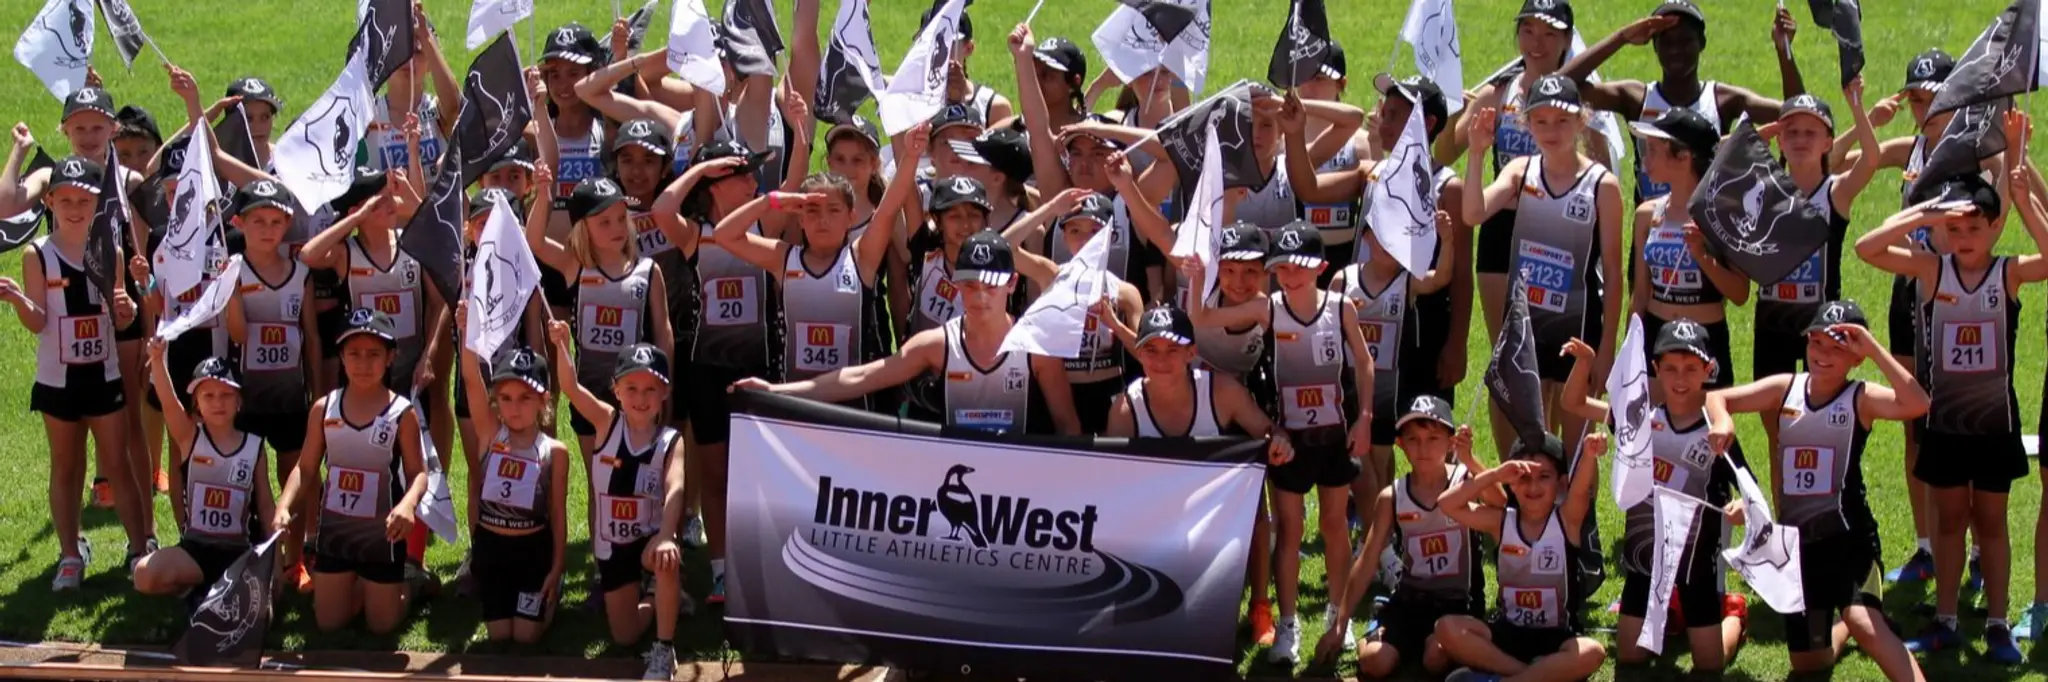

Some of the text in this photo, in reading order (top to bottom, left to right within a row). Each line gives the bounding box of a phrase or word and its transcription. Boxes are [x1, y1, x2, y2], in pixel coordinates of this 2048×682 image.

[1570, 206, 1586, 217] 12
[406, 270, 415, 284] 9
[842, 274, 851, 286] 8
[720, 302, 742, 319] 20
[1988, 296, 1998, 308] 9
[590, 329, 624, 346] 259
[71, 340, 103, 357] 185
[256, 347, 290, 364] 308
[803, 348, 839, 365] 345
[1324, 348, 1334, 361] 9
[1952, 348, 1984, 365] 211
[1306, 408, 1318, 425] 2
[1831, 414, 1846, 424] 10
[379, 430, 388, 443] 9
[237, 470, 247, 482] 9
[1795, 472, 1815, 490] 19
[501, 481, 512, 498] 3
[339, 493, 360, 509] 17
[200, 509, 232, 528] 109
[814, 475, 1098, 553] Inner West
[608, 522, 642, 537] 186
[811, 528, 1092, 576] LITTLE ATHLETICS CENTRE
[1514, 608, 1548, 625] 284
